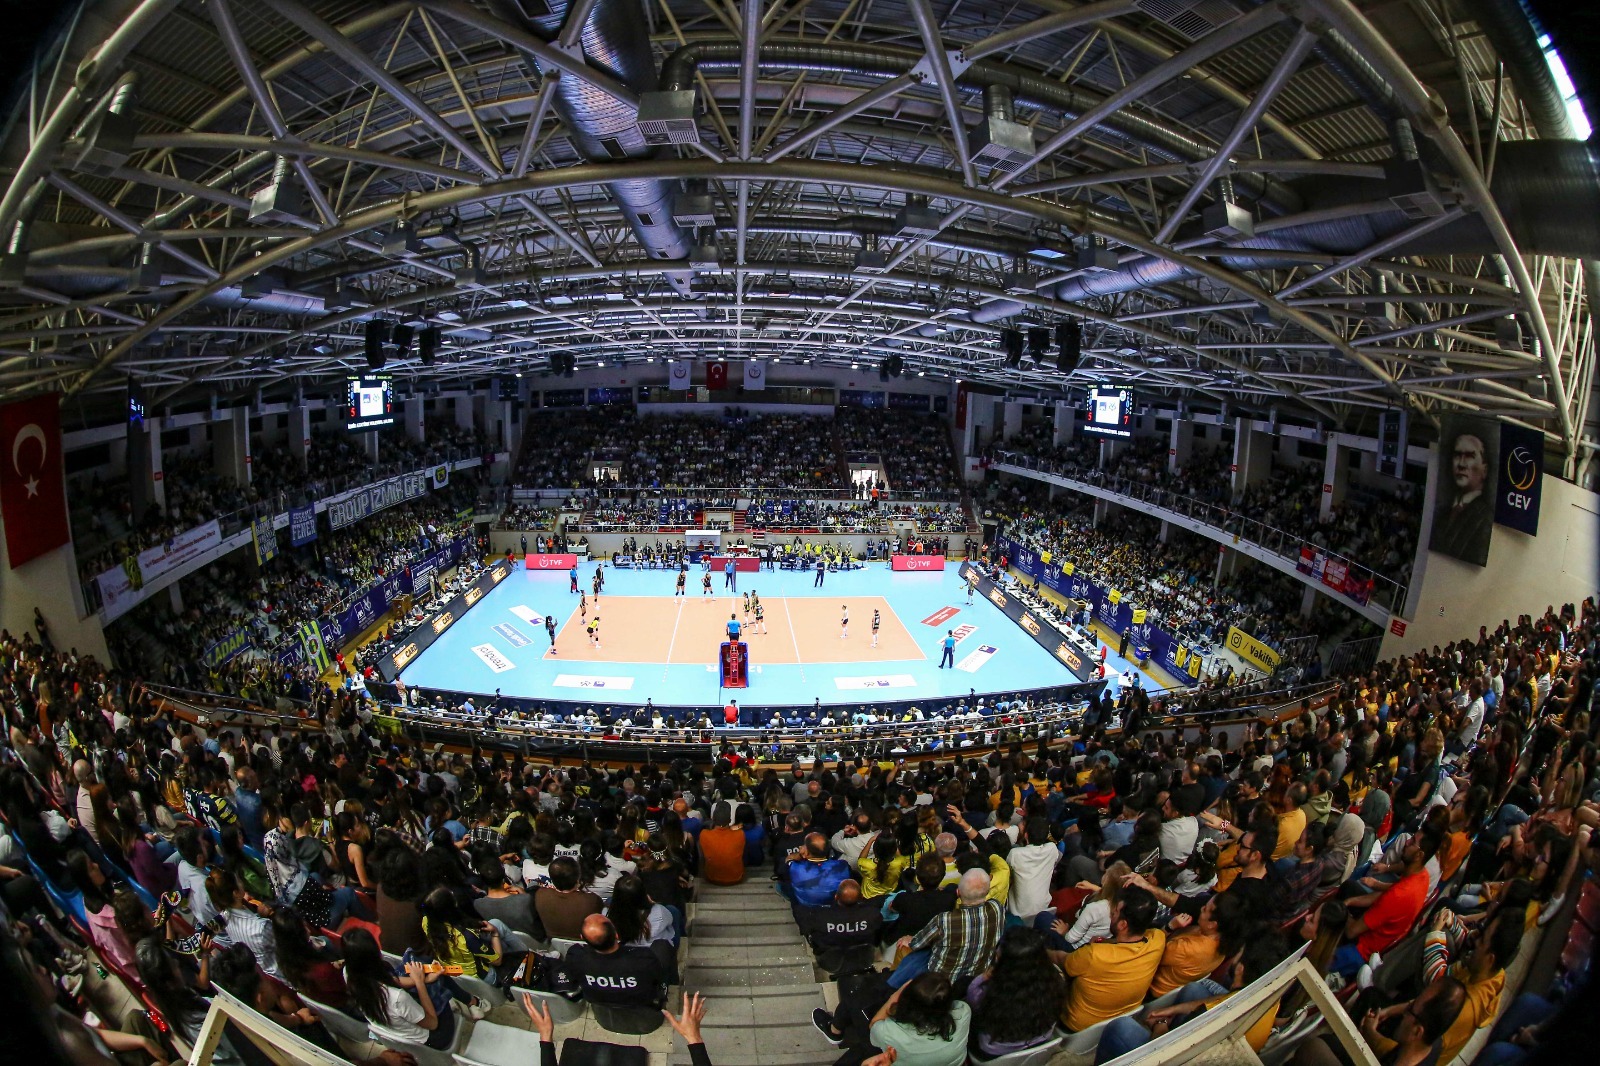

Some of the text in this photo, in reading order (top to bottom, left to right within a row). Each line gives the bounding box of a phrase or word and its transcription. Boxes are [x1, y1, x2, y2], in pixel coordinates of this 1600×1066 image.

[350, 407, 356, 417] 5
[1087, 412, 1092, 421] 5
[1123, 415, 1129, 425] 7
[328, 491, 370, 527] GROUP
[404, 474, 426, 498] GFB
[1507, 491, 1531, 511] CEV
[292, 520, 316, 541] FENER
[214, 631, 245, 664] ADAM
[405, 644, 418, 658] CARD
[1067, 655, 1081, 670] CARD
